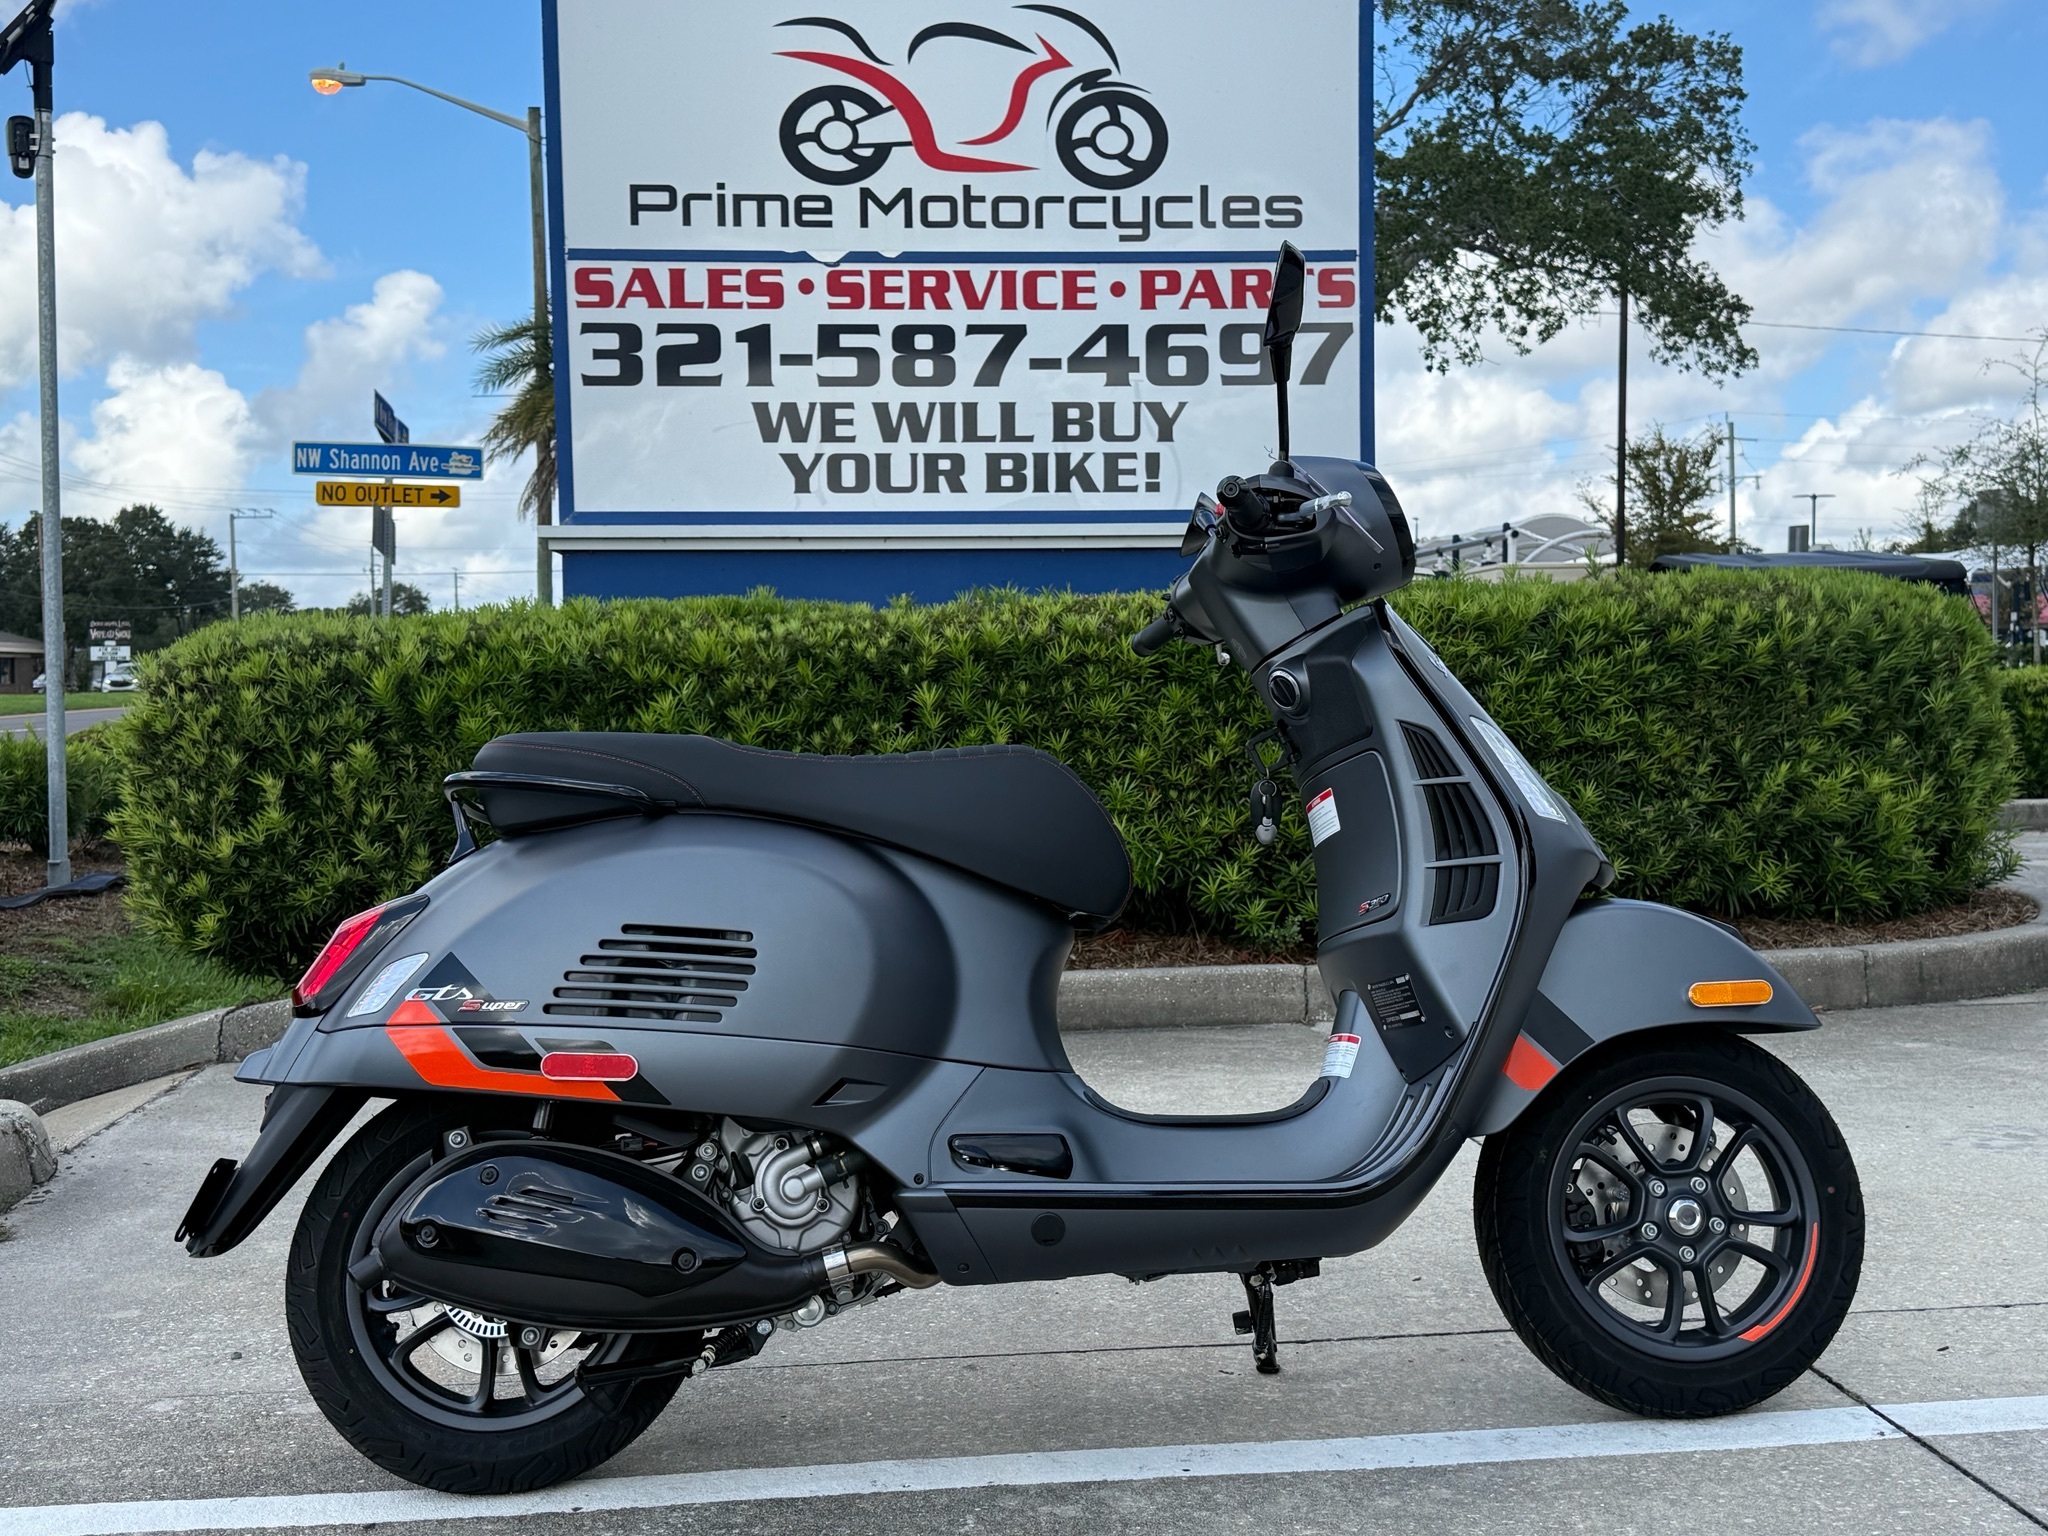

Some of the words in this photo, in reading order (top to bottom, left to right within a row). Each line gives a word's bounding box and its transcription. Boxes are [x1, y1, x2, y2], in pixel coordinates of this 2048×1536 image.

[629, 183, 833, 227] Prime
[859, 187, 1304, 242] Motorcycles
[573, 267, 785, 310] SALES
[826, 269, 1098, 311] SERVICE
[1139, 267, 1357, 310] PARS
[580, 322, 1354, 388] 321-587-4697
[752, 401, 855, 443] WE
[872, 401, 1037, 443] WILL
[1052, 401, 1188, 443] BUY
[297, 448, 321, 468] NW
[329, 448, 401, 471] Shannon
[408, 451, 439, 472] Ave
[779, 453, 967, 494] YOUR
[984, 452, 1161, 494] BIKE!
[321, 485, 346, 501] NO
[355, 486, 424, 504] OUTLET
[457, 999, 526, 1012] Super
